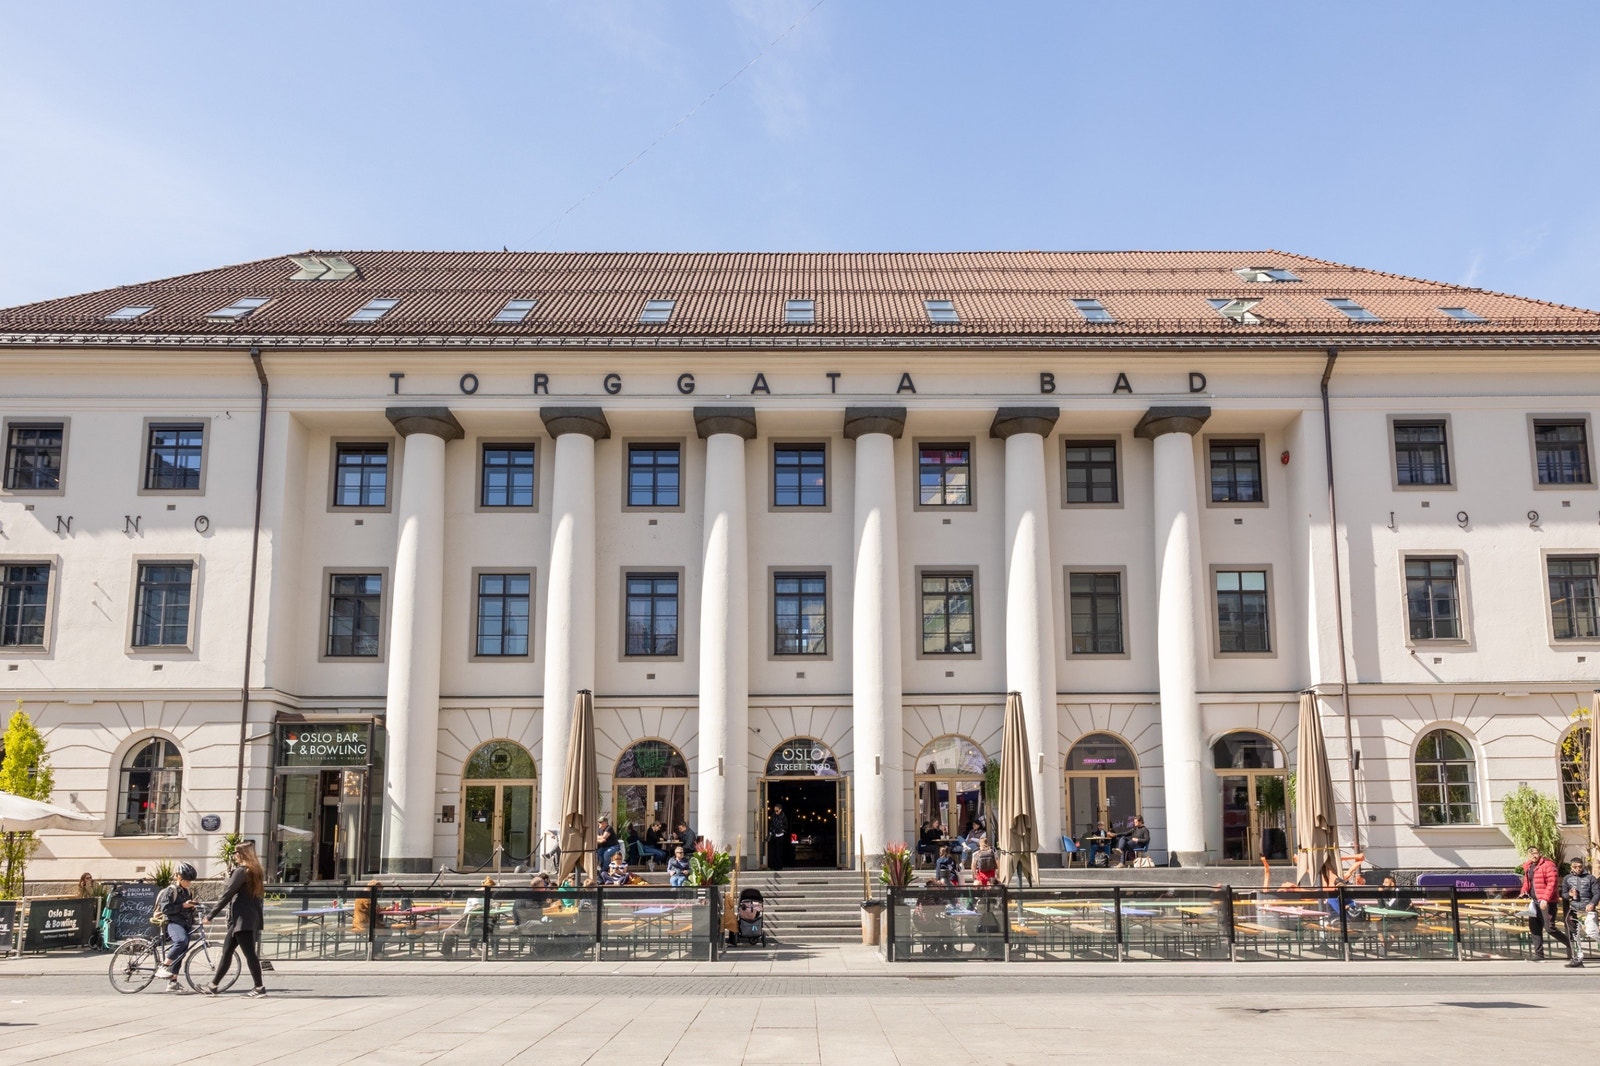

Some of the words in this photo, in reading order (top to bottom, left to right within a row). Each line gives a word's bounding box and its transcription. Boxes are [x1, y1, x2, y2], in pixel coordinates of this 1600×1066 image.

[389, 373, 917, 395] TORGGATA
[1040, 372, 1207, 394] BAD
[0, 514, 210, 535] NNO
[1387, 510, 1600, 529] 192
[300, 732, 333, 743] OSLO
[336, 732, 359, 743] BAR
[299, 745, 308, 755] &
[309, 744, 367, 755] BOWLING
[782, 748, 823, 761] OSLO
[774, 763, 802, 771] STREET
[805, 763, 831, 771] FOOD
[48, 909, 63, 918] Oslo
[63, 909, 75, 918] Bar
[52, 918, 77, 929] Bowling
